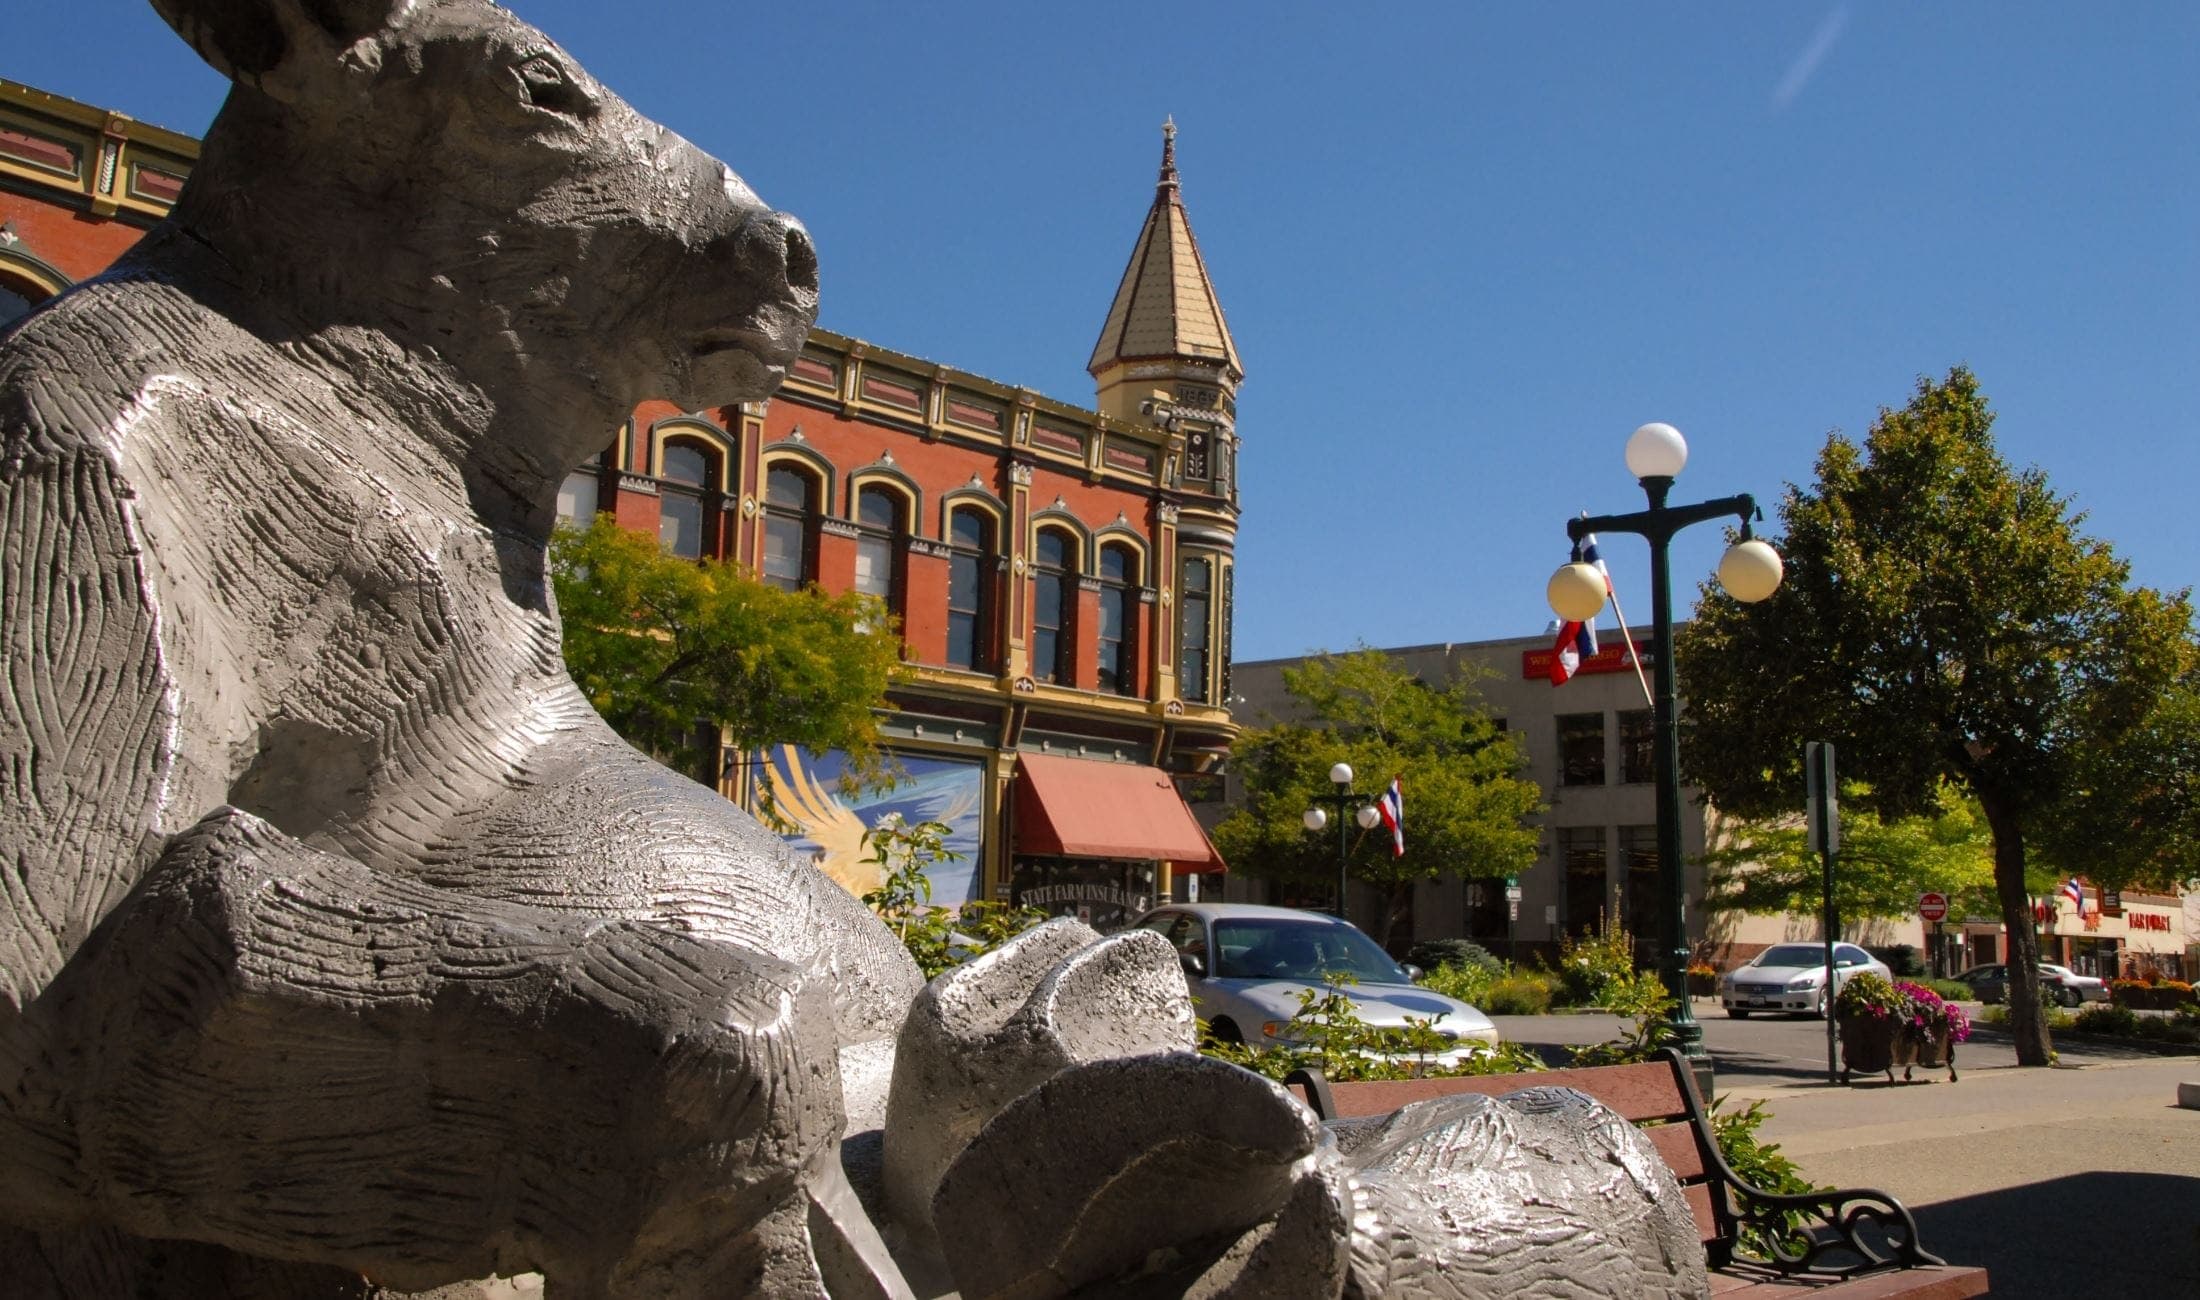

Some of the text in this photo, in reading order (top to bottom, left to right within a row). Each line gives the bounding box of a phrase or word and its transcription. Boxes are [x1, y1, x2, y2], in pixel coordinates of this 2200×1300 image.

[1020, 886, 1053, 907] STATE
[1055, 884, 1084, 901] FARM
[1087, 884, 1147, 913] INSURANCE
